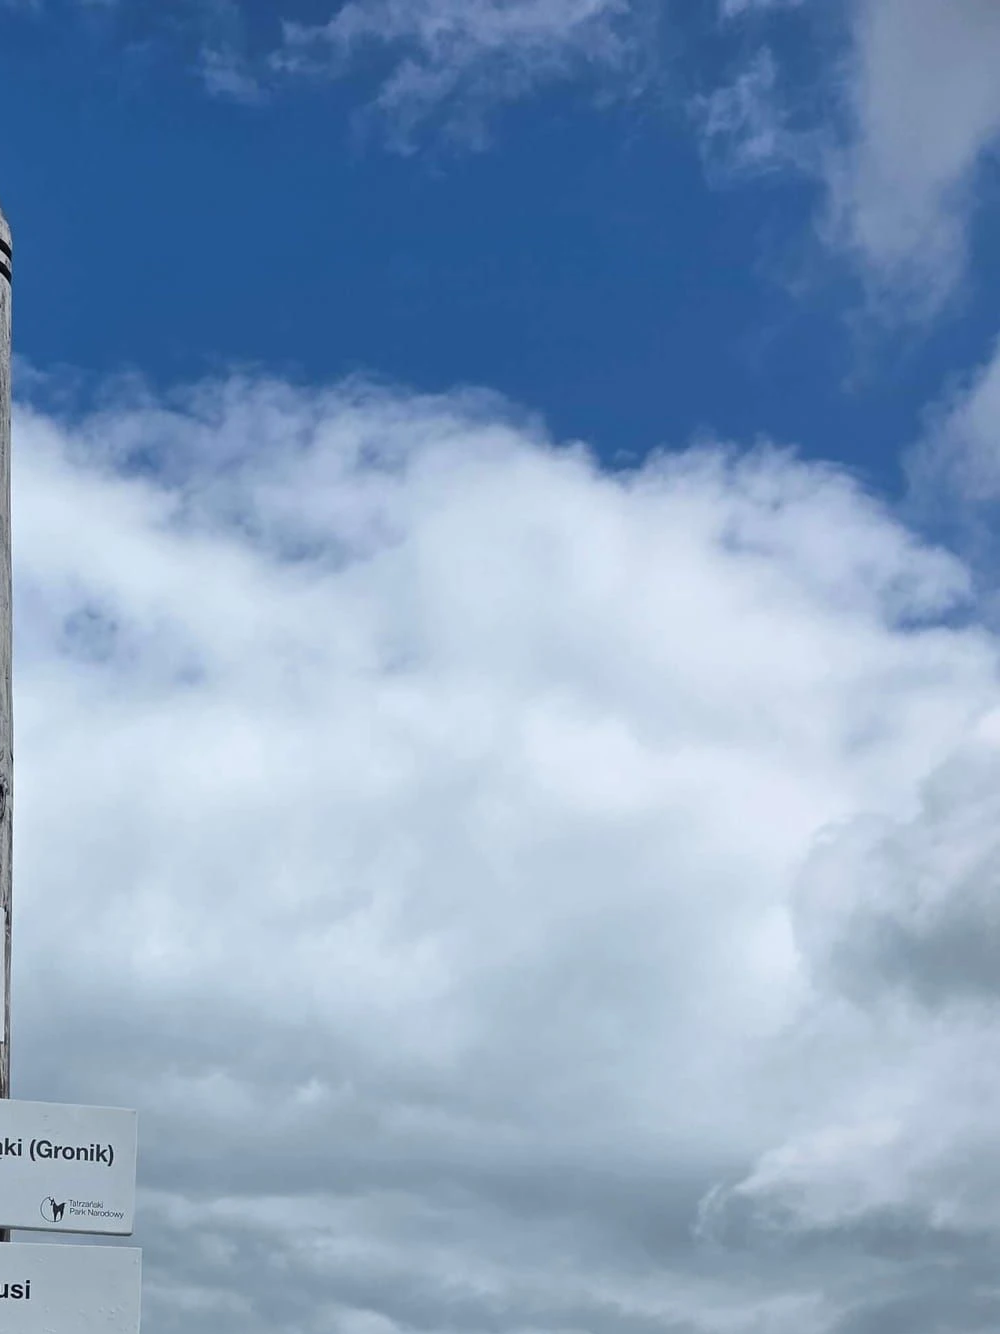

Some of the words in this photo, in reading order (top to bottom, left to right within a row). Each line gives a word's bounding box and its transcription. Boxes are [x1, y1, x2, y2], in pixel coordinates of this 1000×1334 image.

[30, 1139, 114, 1166] (Gronik)
[69, 1199, 103, 1208] Tatrzański
[70, 1208, 86, 1216] Park
[88, 1209, 124, 1219] Narodowy
